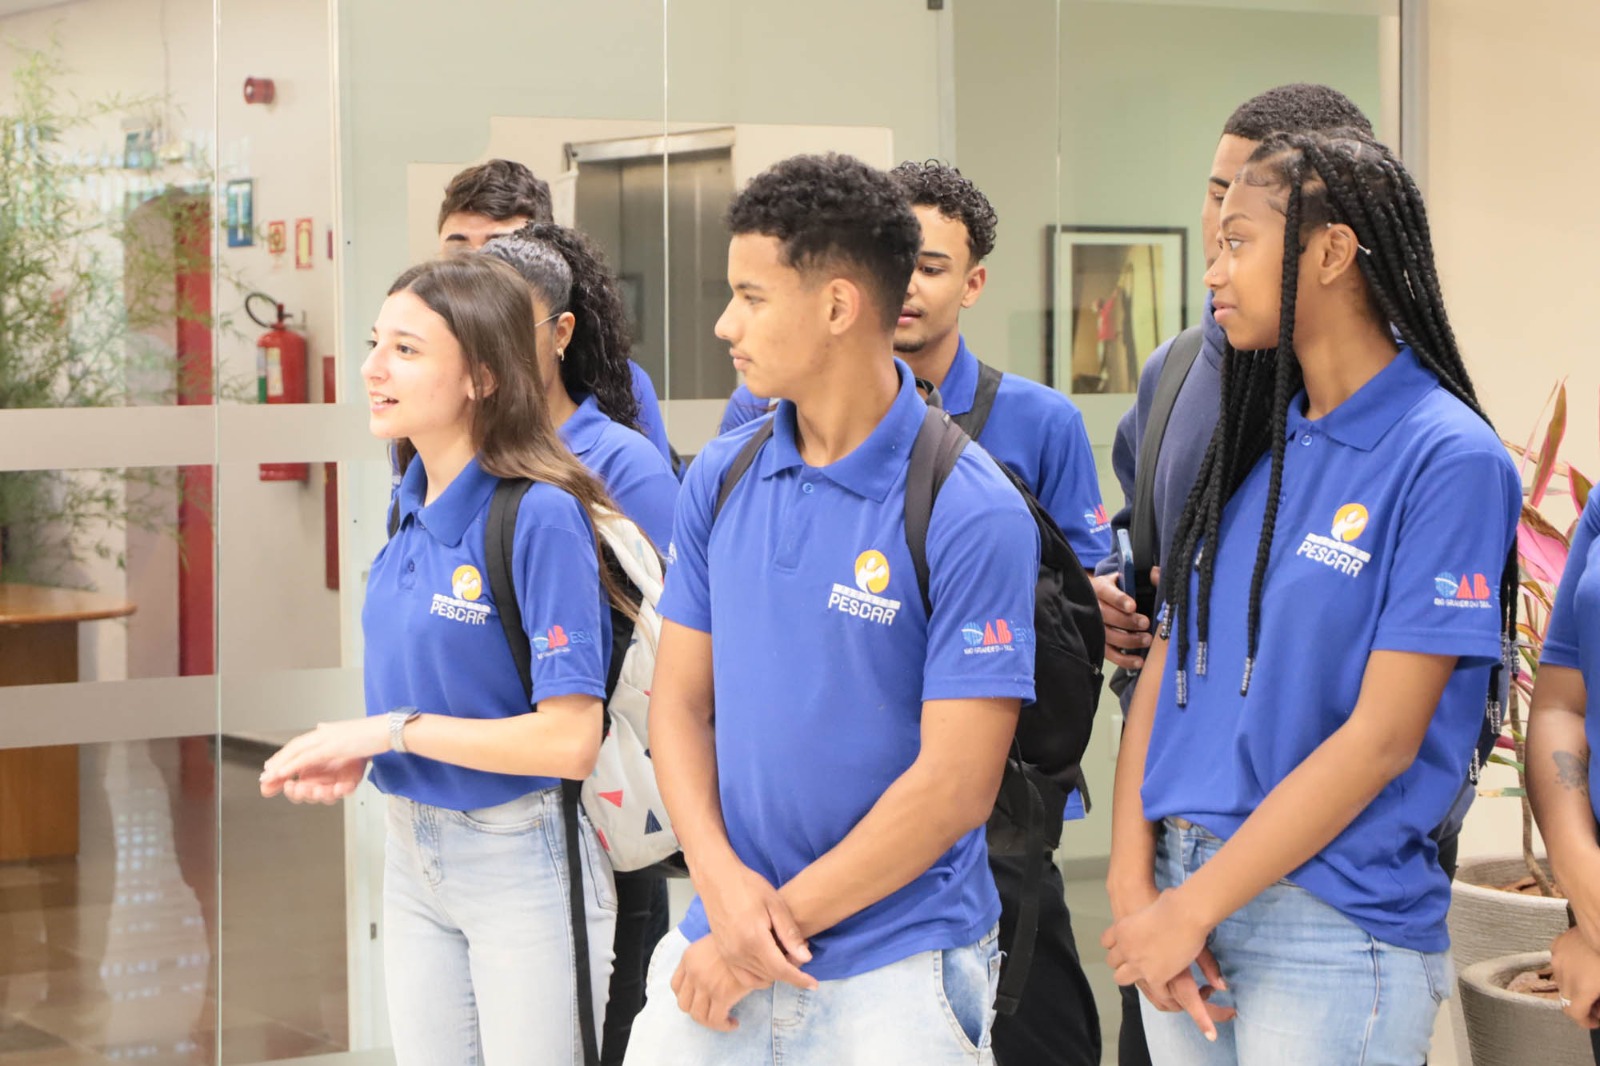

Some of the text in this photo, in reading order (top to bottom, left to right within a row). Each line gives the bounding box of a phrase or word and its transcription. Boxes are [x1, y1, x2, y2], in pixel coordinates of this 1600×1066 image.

[1296, 541, 1364, 578] PESCAR
[430, 601, 488, 625] PESCAR
[828, 593, 895, 625] PESCAR
